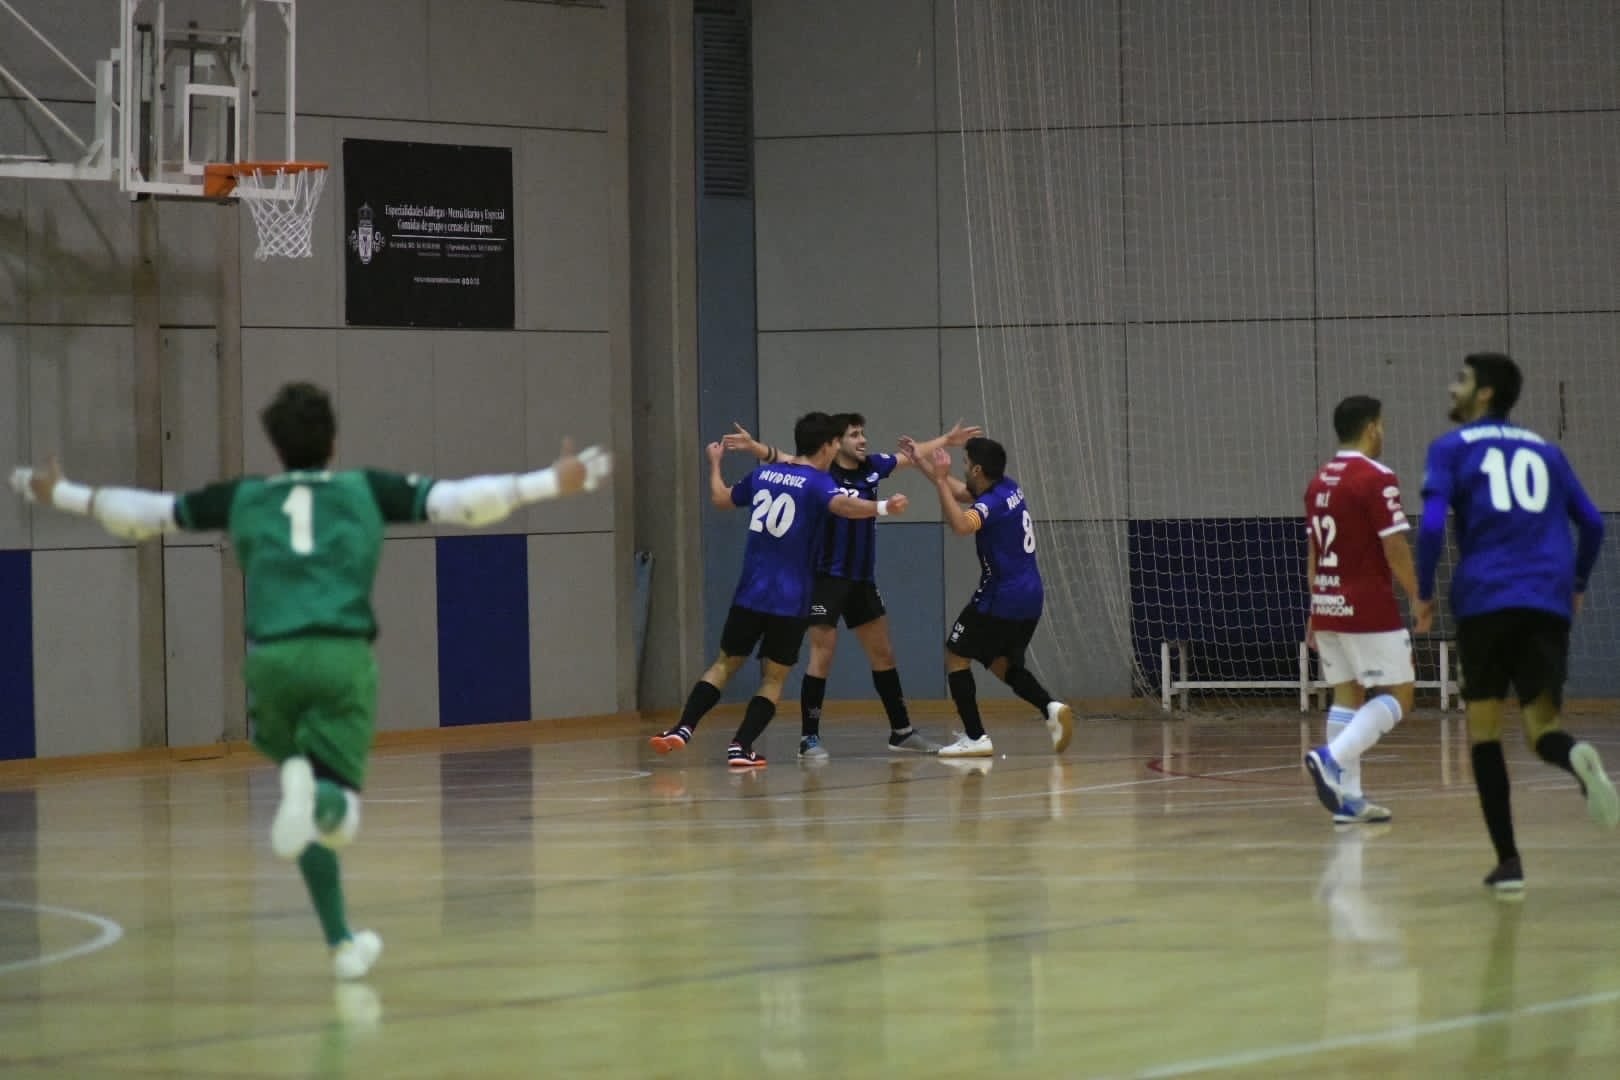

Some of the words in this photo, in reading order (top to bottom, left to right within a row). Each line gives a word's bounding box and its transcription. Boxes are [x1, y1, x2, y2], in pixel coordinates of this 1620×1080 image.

[781, 473, 807, 489] RUIZ
[1479, 446, 1549, 513] 10
[281, 484, 314, 556] 1
[749, 488, 796, 538] 20
[1022, 509, 1036, 554] 8
[1312, 514, 1337, 568] 12
